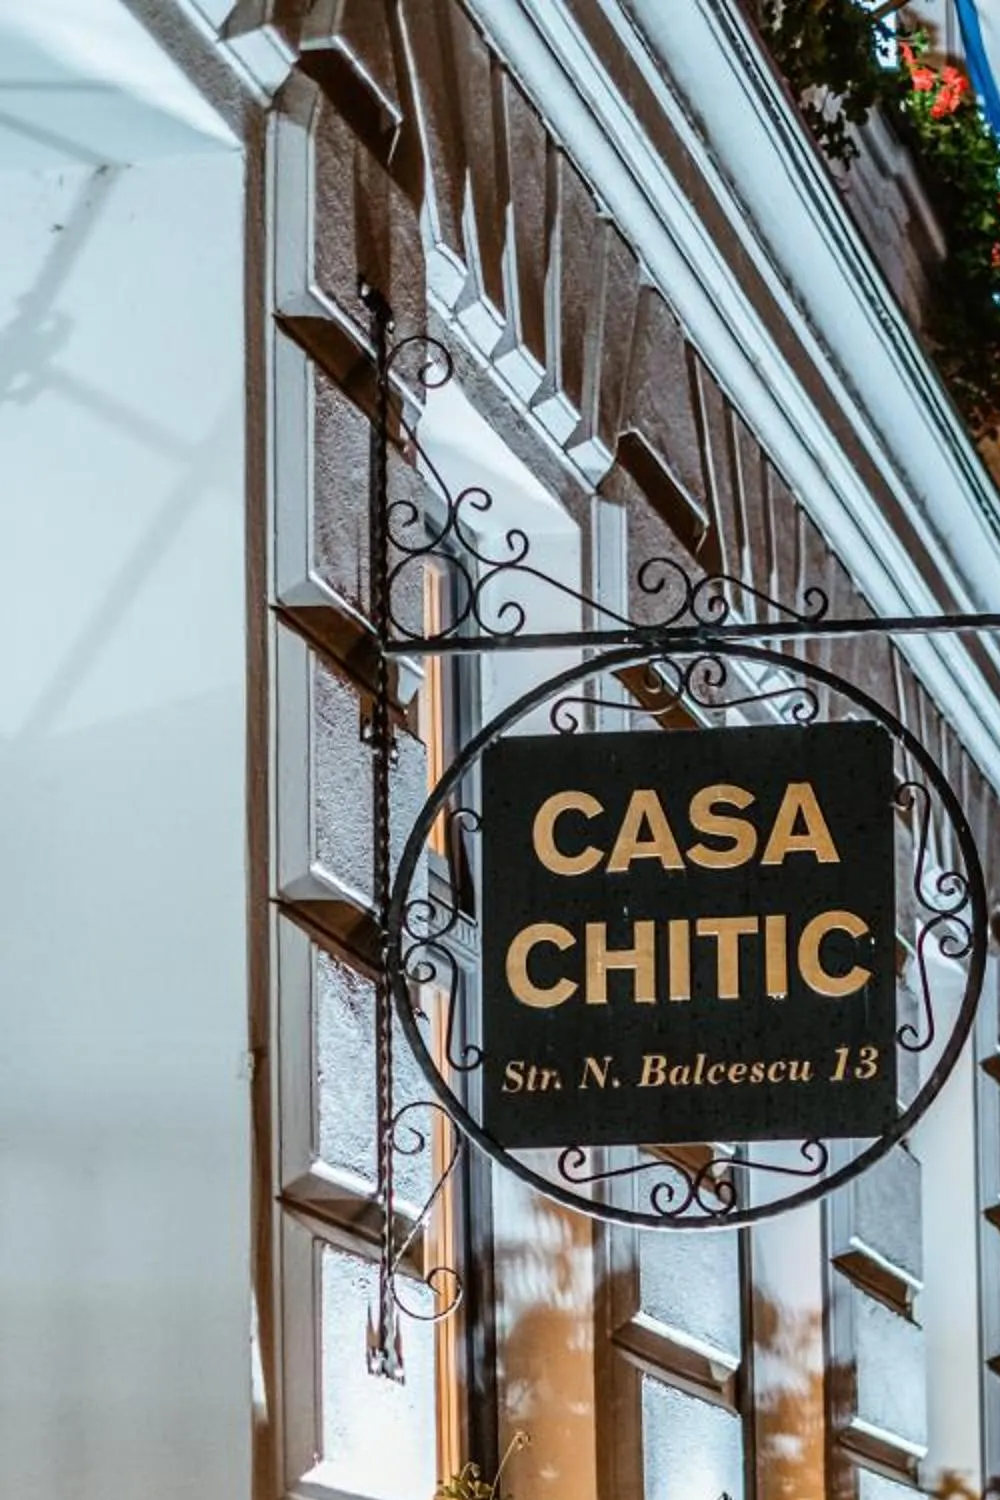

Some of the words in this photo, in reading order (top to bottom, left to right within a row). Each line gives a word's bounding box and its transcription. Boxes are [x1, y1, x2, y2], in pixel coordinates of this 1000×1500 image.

[532, 782, 841, 877] CASA
[505, 910, 872, 1009] CHITIC
[501, 1060, 562, 1093] Str.
[579, 1056, 622, 1089] N.
[637, 1053, 813, 1088] Balcescu
[829, 1046, 881, 1083] 13
